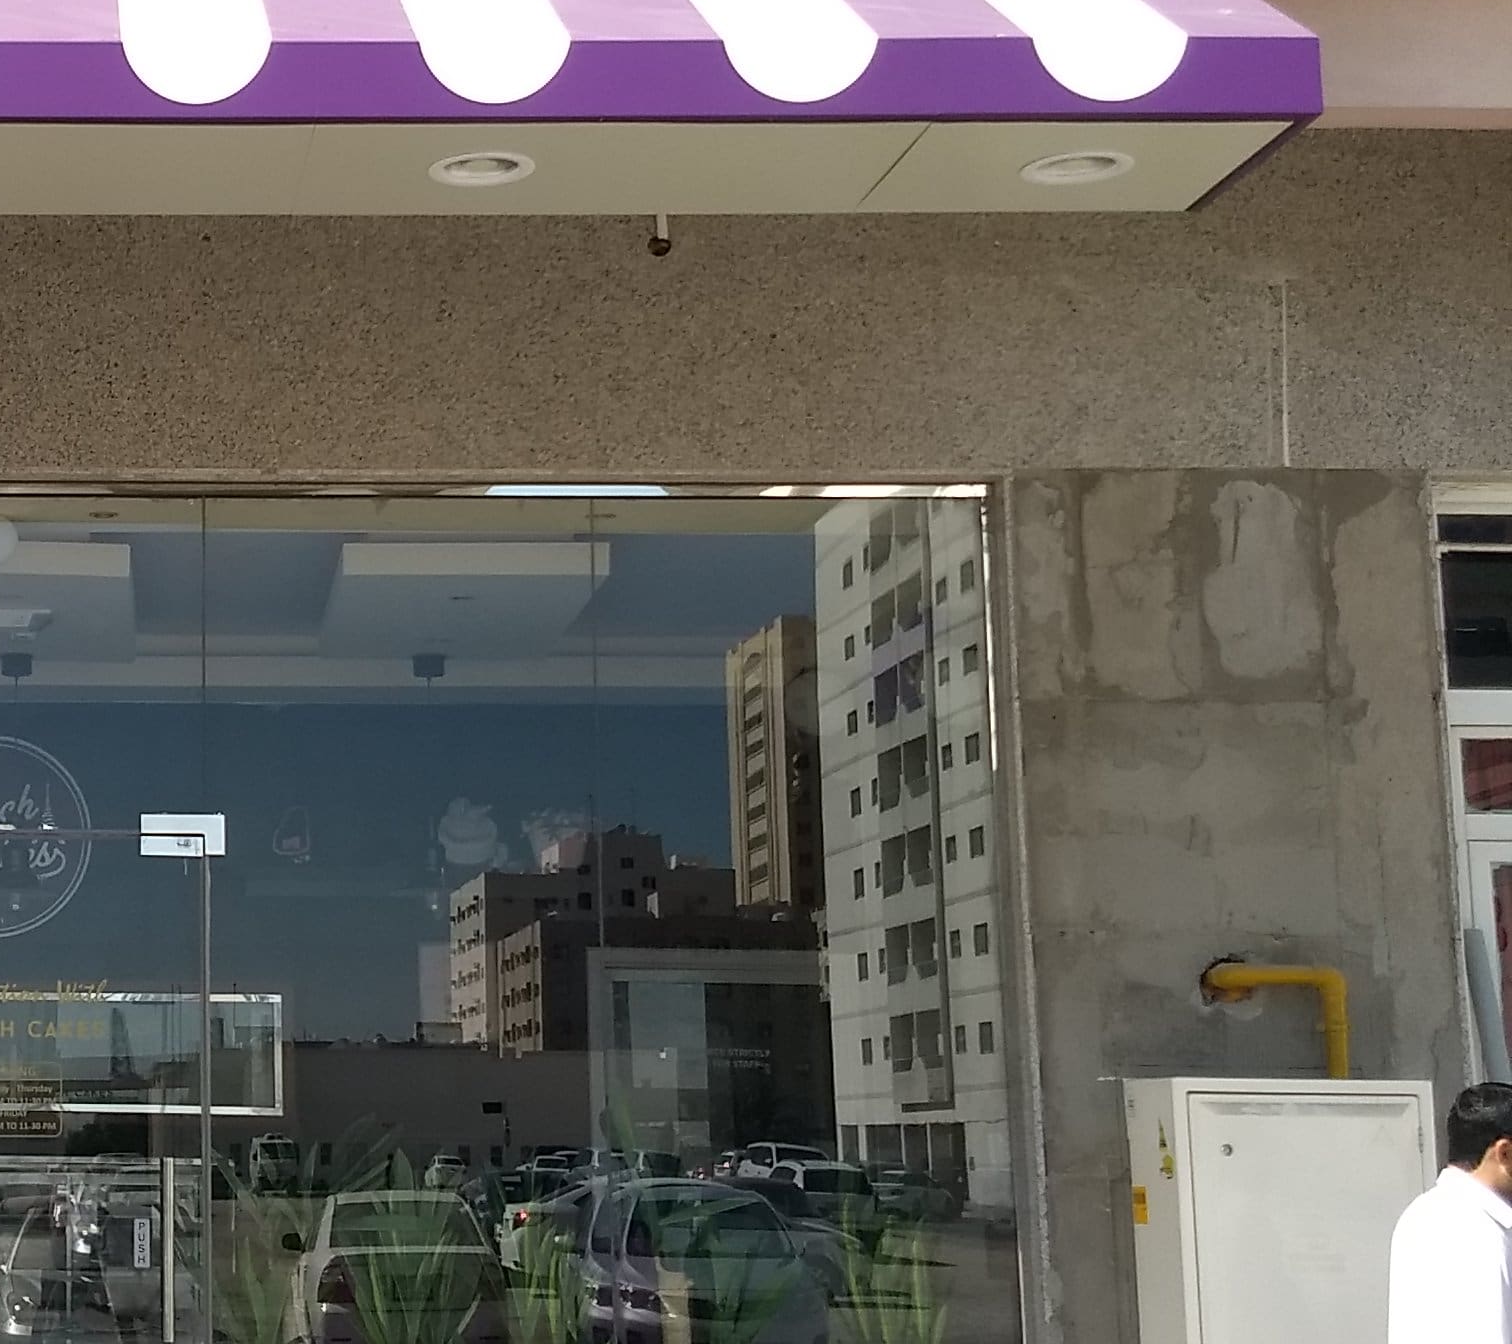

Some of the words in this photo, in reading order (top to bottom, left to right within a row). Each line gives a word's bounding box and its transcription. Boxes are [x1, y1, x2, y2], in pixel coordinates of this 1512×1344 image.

[6, 1121, 17, 1130] TO
[42, 1121, 57, 1130] PM
[137, 1221, 146, 1263] PUSH
